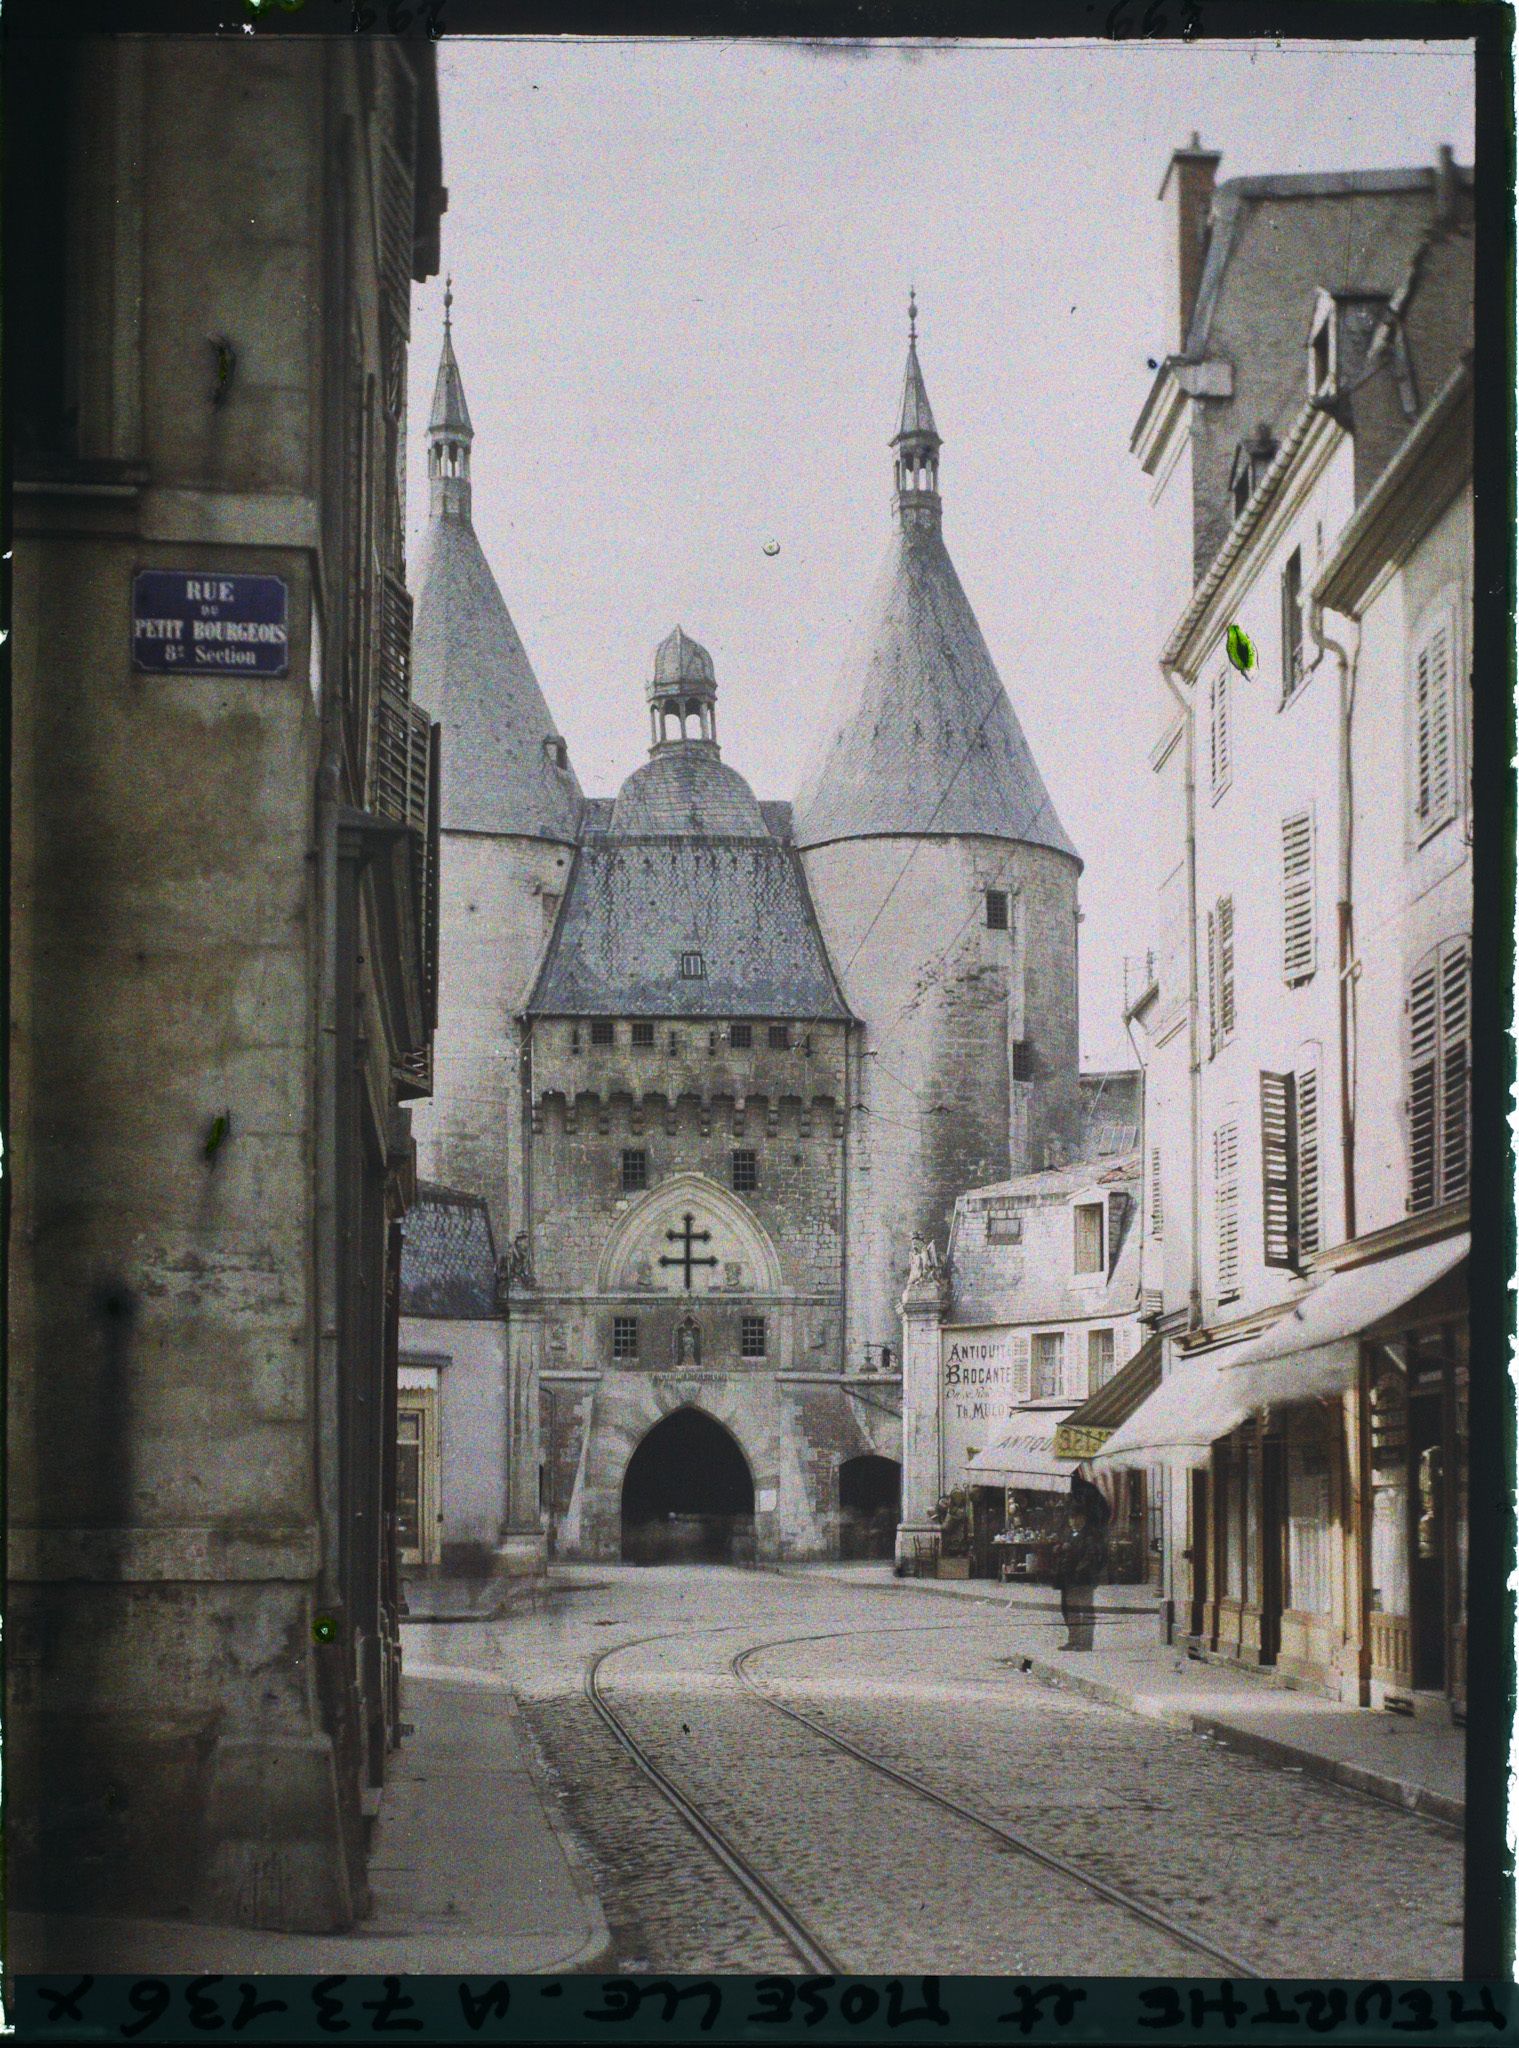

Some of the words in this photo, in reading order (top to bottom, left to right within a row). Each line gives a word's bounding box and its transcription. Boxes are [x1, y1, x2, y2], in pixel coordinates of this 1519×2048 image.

[186, 580, 235, 602] RUE
[134, 618, 184, 640] PETIT
[192, 620, 288, 643] BOURGEOIS
[195, 644, 257, 666] Section
[944, 1364, 1012, 1386] BROCANTE
[996, 1434, 1055, 1454] ANTIQU
[1138, 1979, 1507, 2033] MEURTHE
